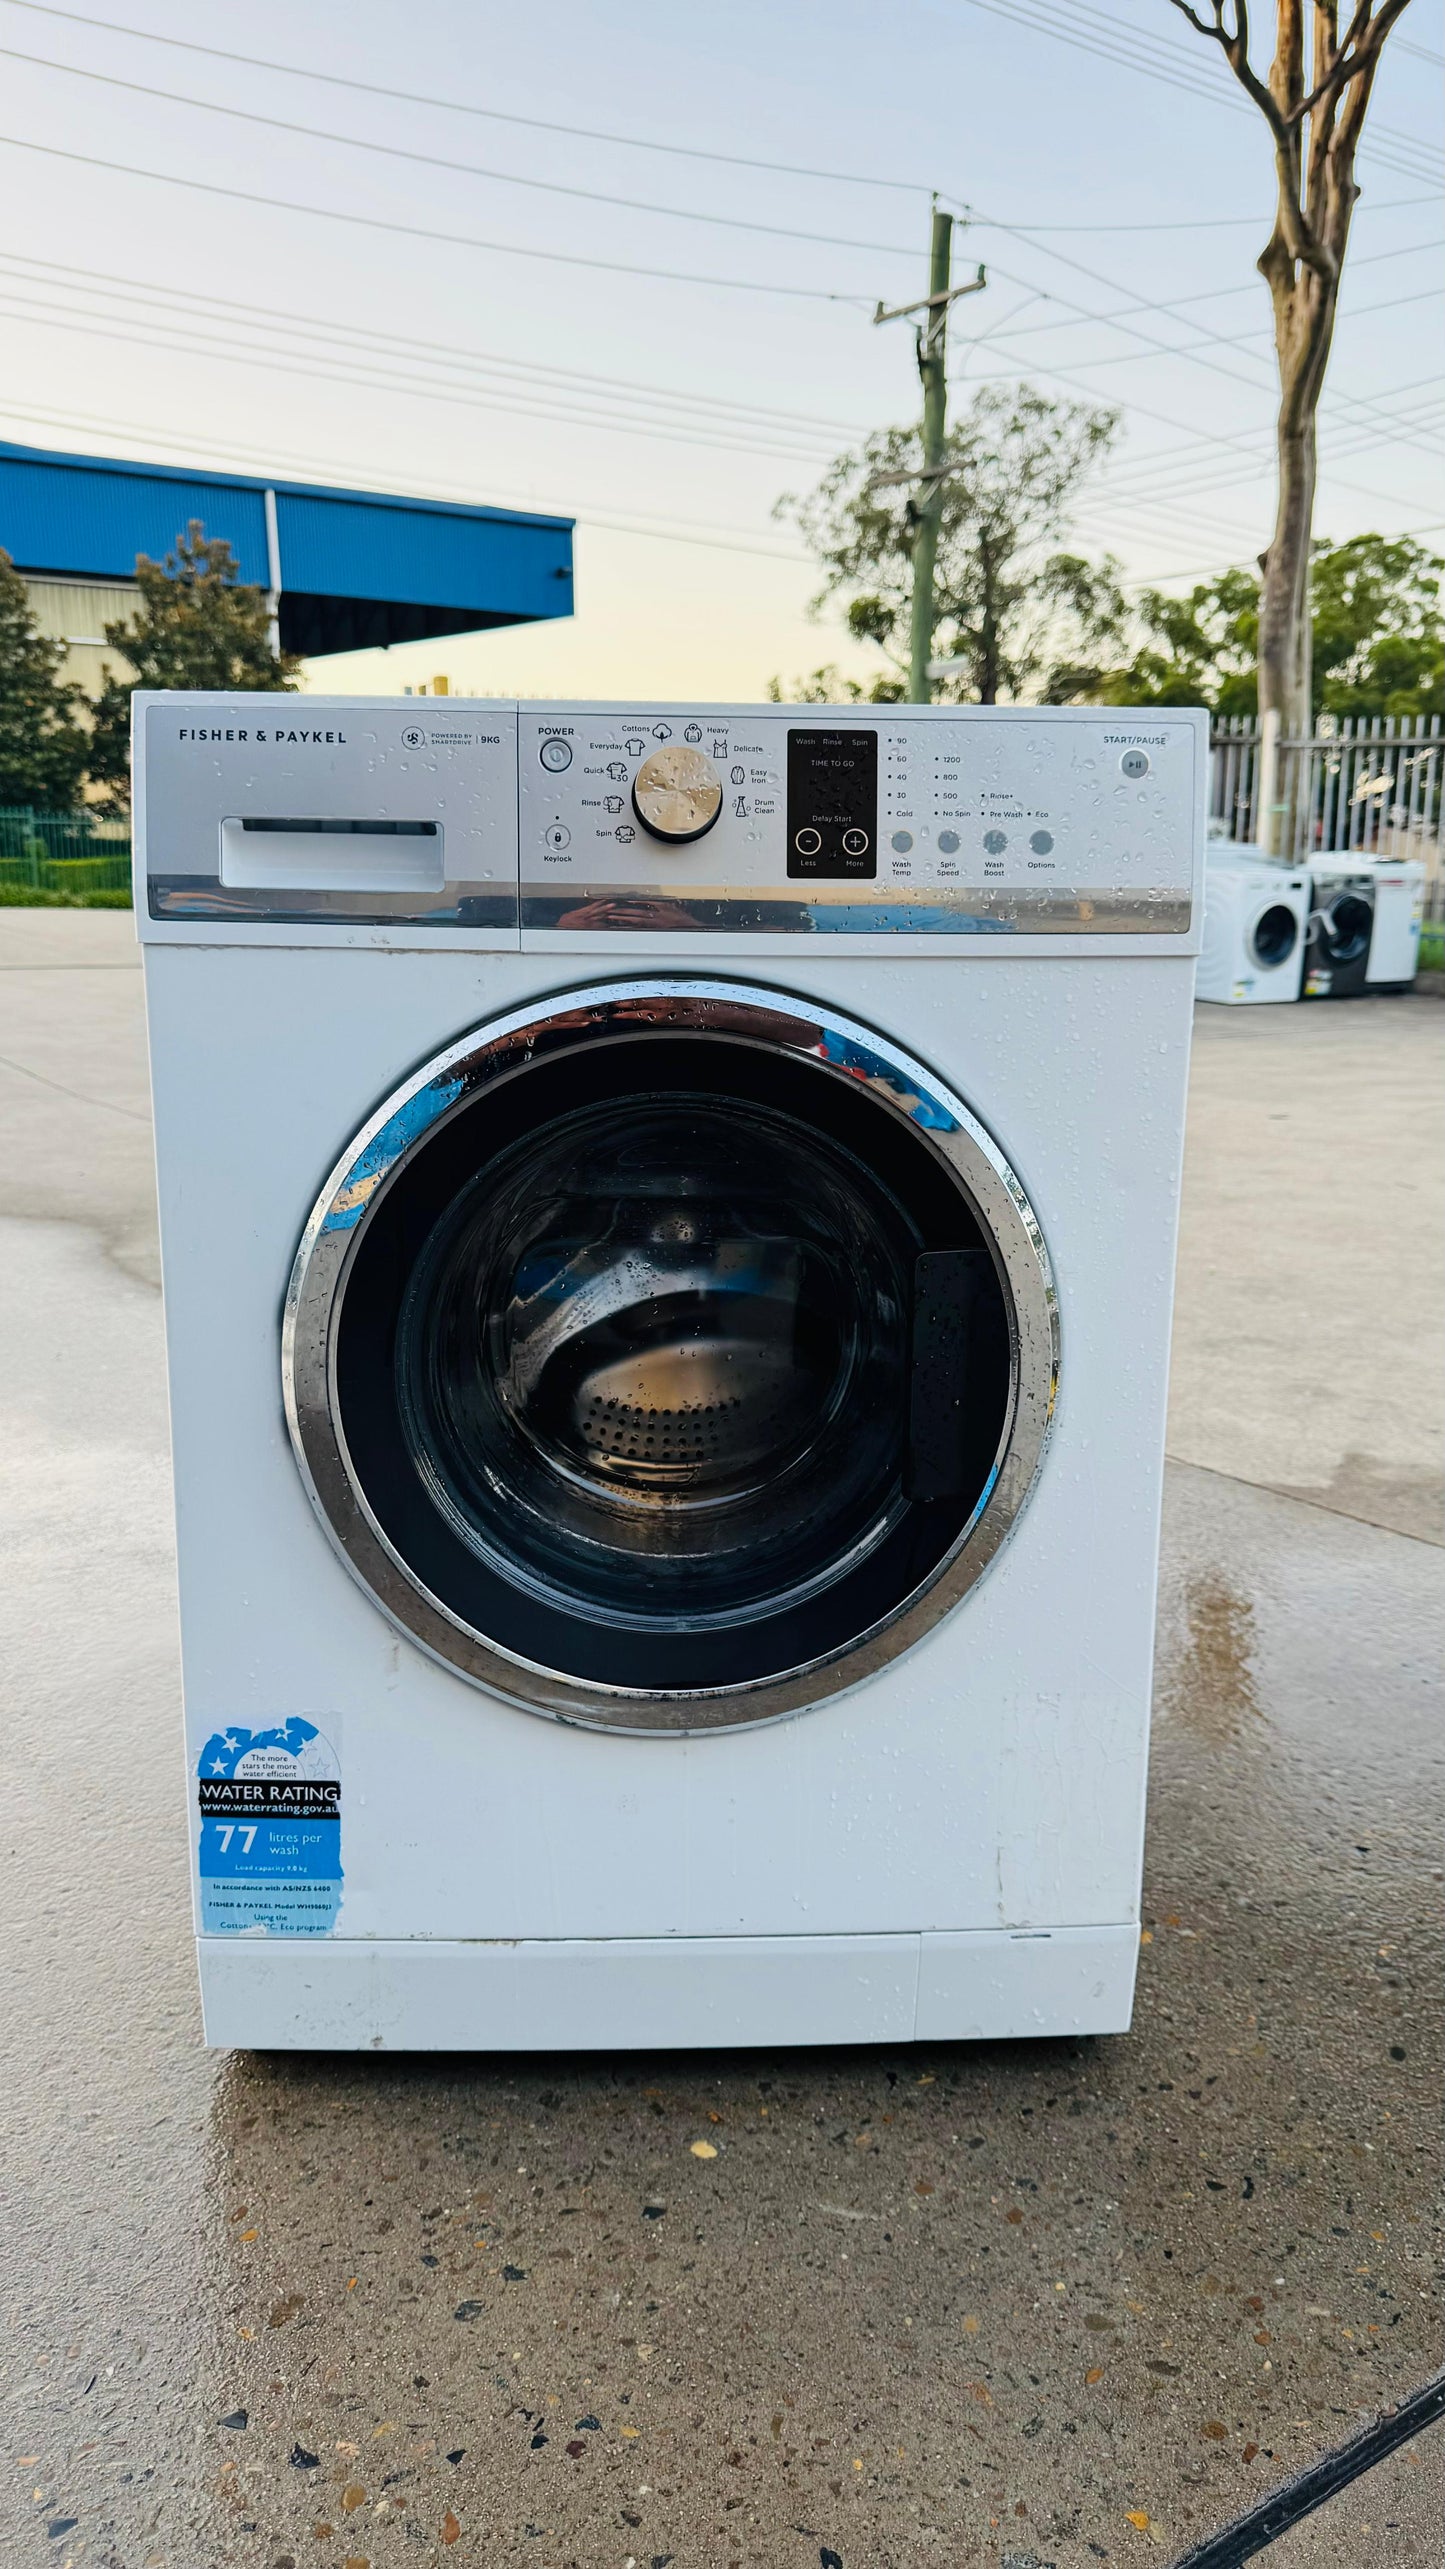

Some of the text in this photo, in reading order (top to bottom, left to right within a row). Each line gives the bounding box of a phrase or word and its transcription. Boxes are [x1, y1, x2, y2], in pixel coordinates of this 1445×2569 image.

[538, 727, 574, 736] POWER
[622, 725, 650, 733] Cottons
[706, 726, 729, 735] Heavy
[179, 729, 347, 743] FISHER & PAYKEL
[481, 735, 500, 744] 9KG
[1104, 735, 1166, 745] START/PAUSE
[822, 738, 842, 746] Rinse
[852, 739, 868, 747] Spin
[589, 743, 623, 751] Everyday
[733, 745, 763, 753] Delicate
[583, 767, 604, 775] Quick
[750, 769, 767, 777] Easy
[616, 774, 628, 782] 30
[812, 815, 832, 823] Delay
[596, 829, 612, 838] Spin
[543, 855, 572, 863] Keylock
[940, 861, 956, 869] Spin
[892, 869, 911, 877] Temp
[937, 869, 960, 877] Speed
[202, 1784, 337, 1801] WATER RATING
[202, 1803, 339, 1815] www.waterrating.gov.au
[215, 1825, 258, 1855] 77
[269, 1831, 322, 1846] litres per
[269, 1845, 299, 1855] wash
[299, 1865, 308, 1873] kg
[282, 1884, 311, 1892] AS/NZS
[254, 1913, 274, 1921] Using
[281, 1921, 295, 1930] Eco
[296, 1923, 327, 1932] program
